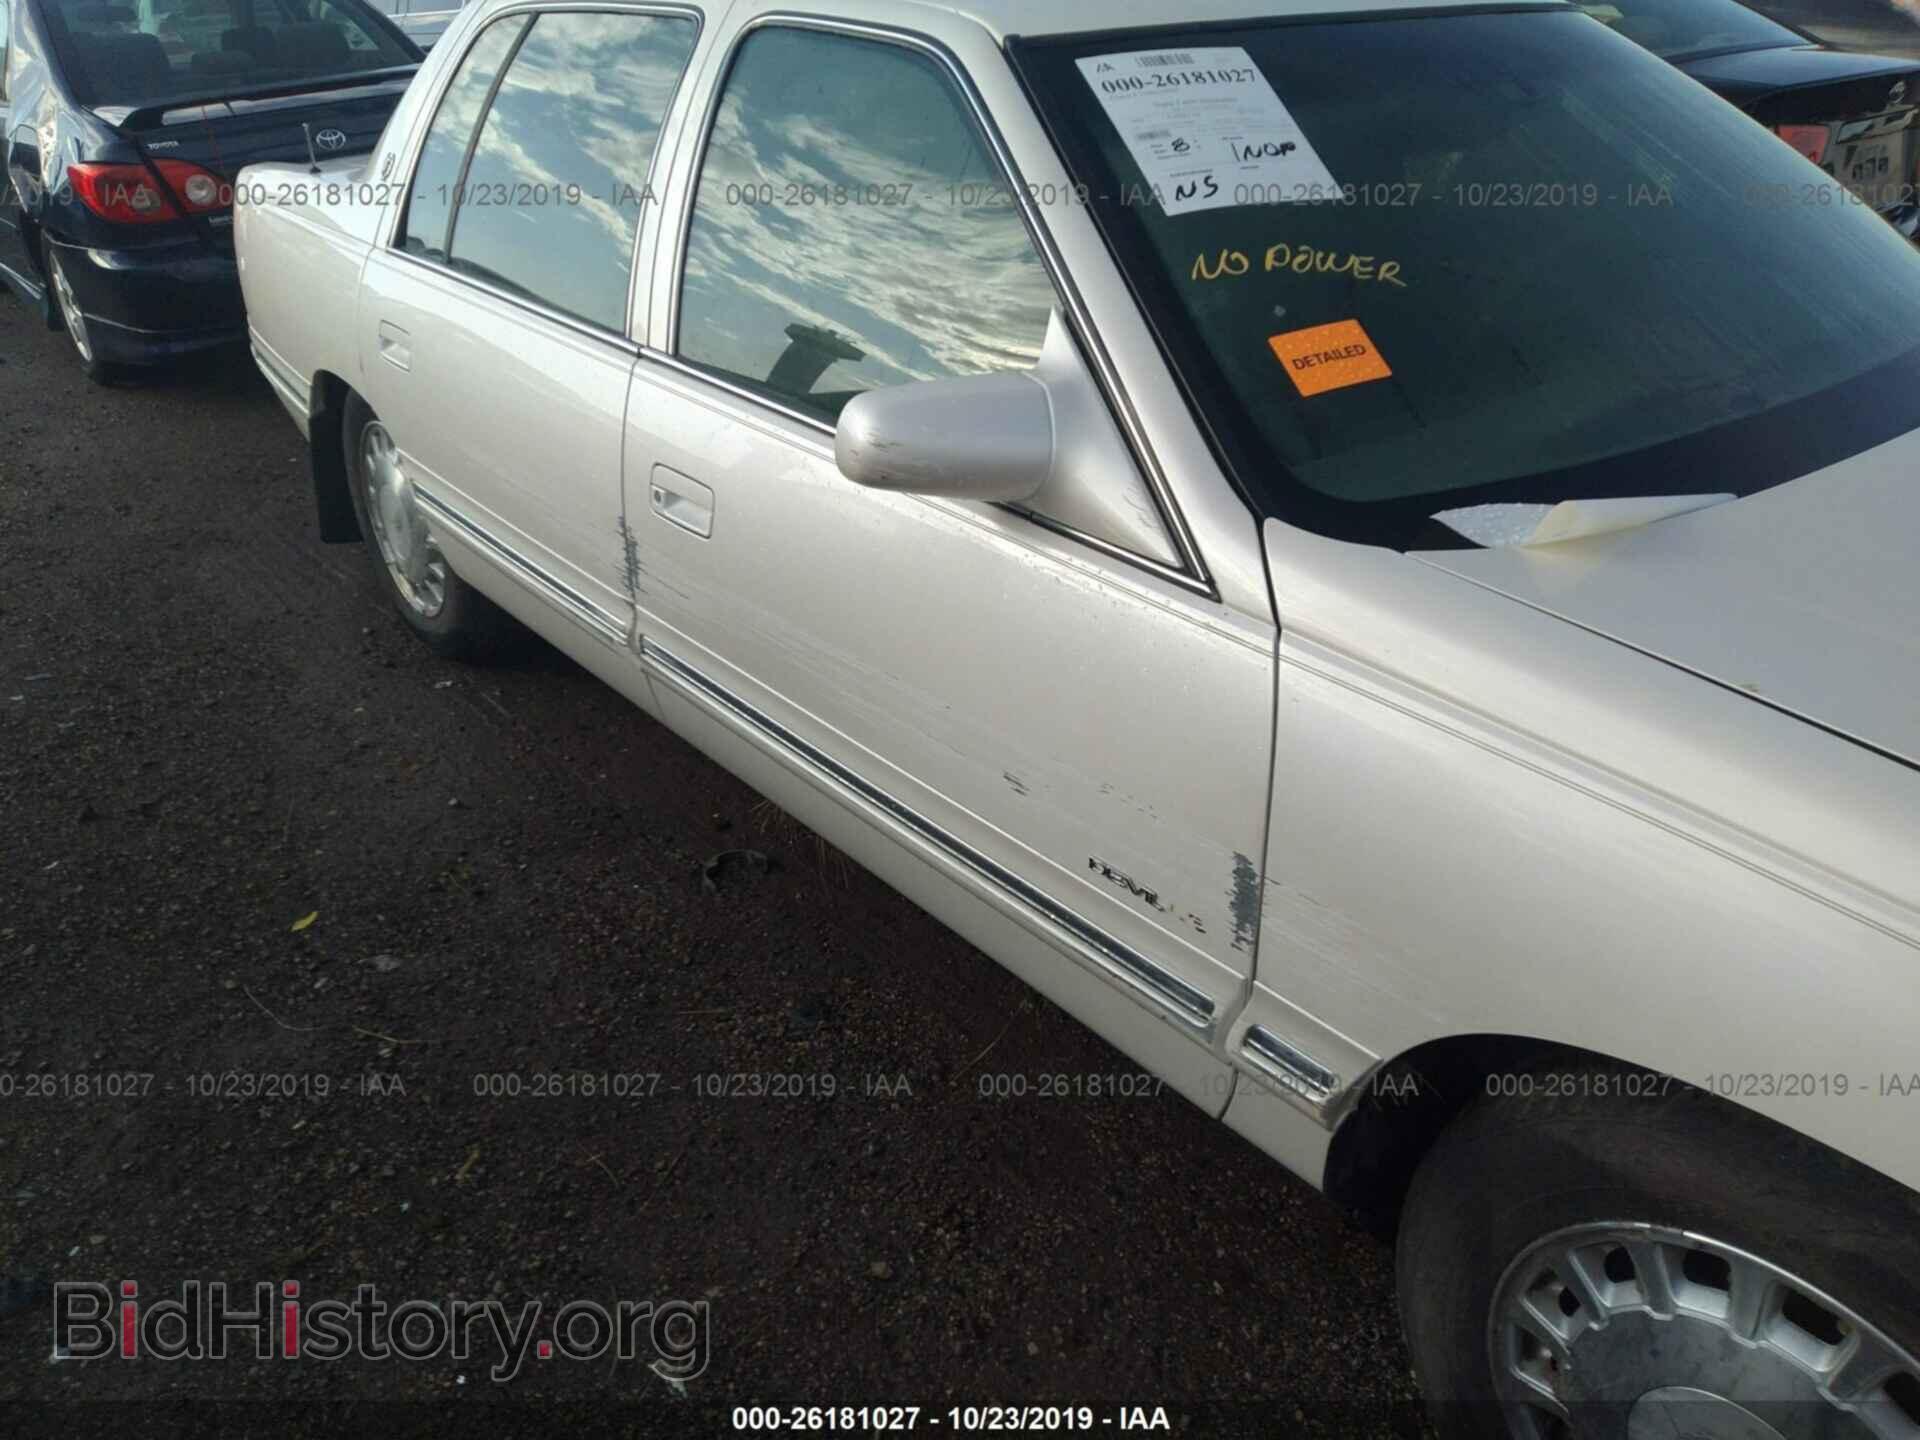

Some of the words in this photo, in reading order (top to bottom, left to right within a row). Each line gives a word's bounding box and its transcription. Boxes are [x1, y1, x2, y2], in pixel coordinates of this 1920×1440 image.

[1101, 68, 1256, 94] 000-26181027
[1191, 248, 1249, 280] NO
[1291, 343, 1367, 371] DETAILED
